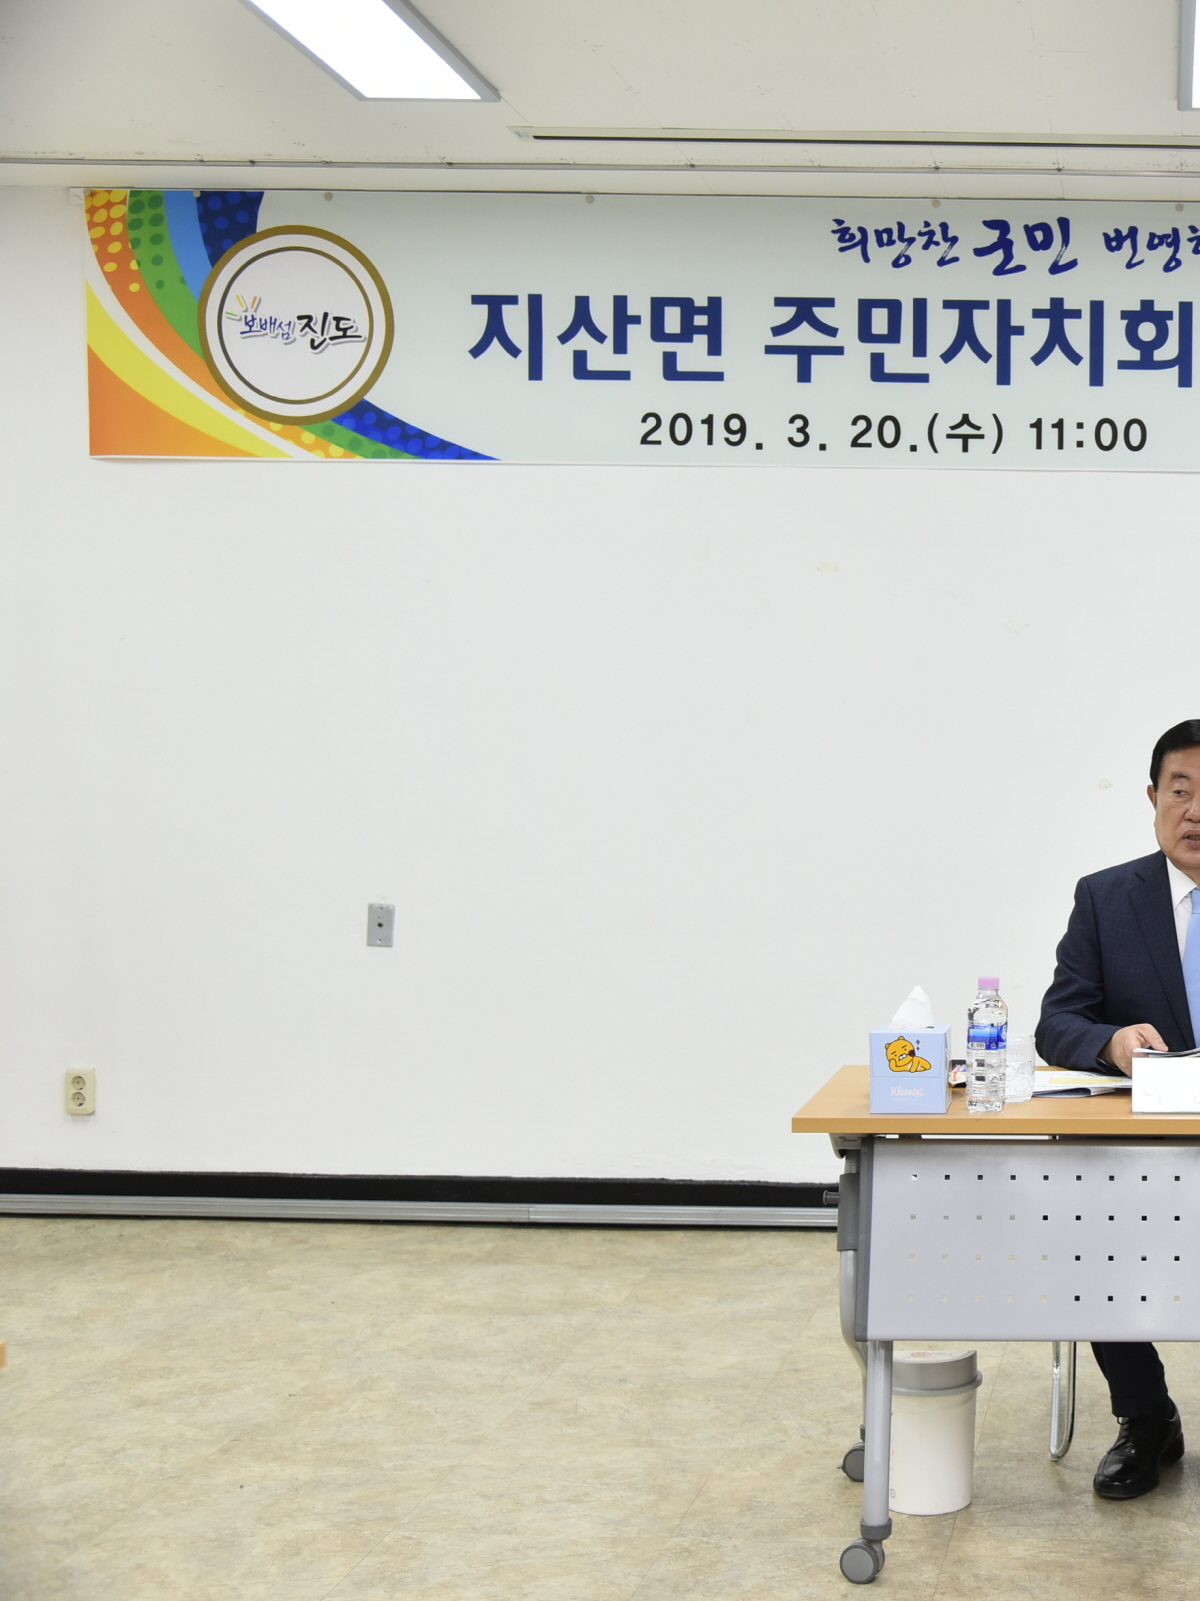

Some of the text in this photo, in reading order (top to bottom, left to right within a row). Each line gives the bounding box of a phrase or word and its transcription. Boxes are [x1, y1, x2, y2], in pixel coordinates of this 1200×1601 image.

[831, 219, 960, 268] 희망찬
[240, 311, 362, 350] 보배섬 진도
[468, 293, 724, 381] 지산면
[765, 296, 1194, 388] 주민자치회
[640, 412, 764, 451] 2019.
[787, 413, 827, 451] 3.
[1029, 417, 1148, 452] 11:00
[891, 1087, 924, 1098] Kleenex
